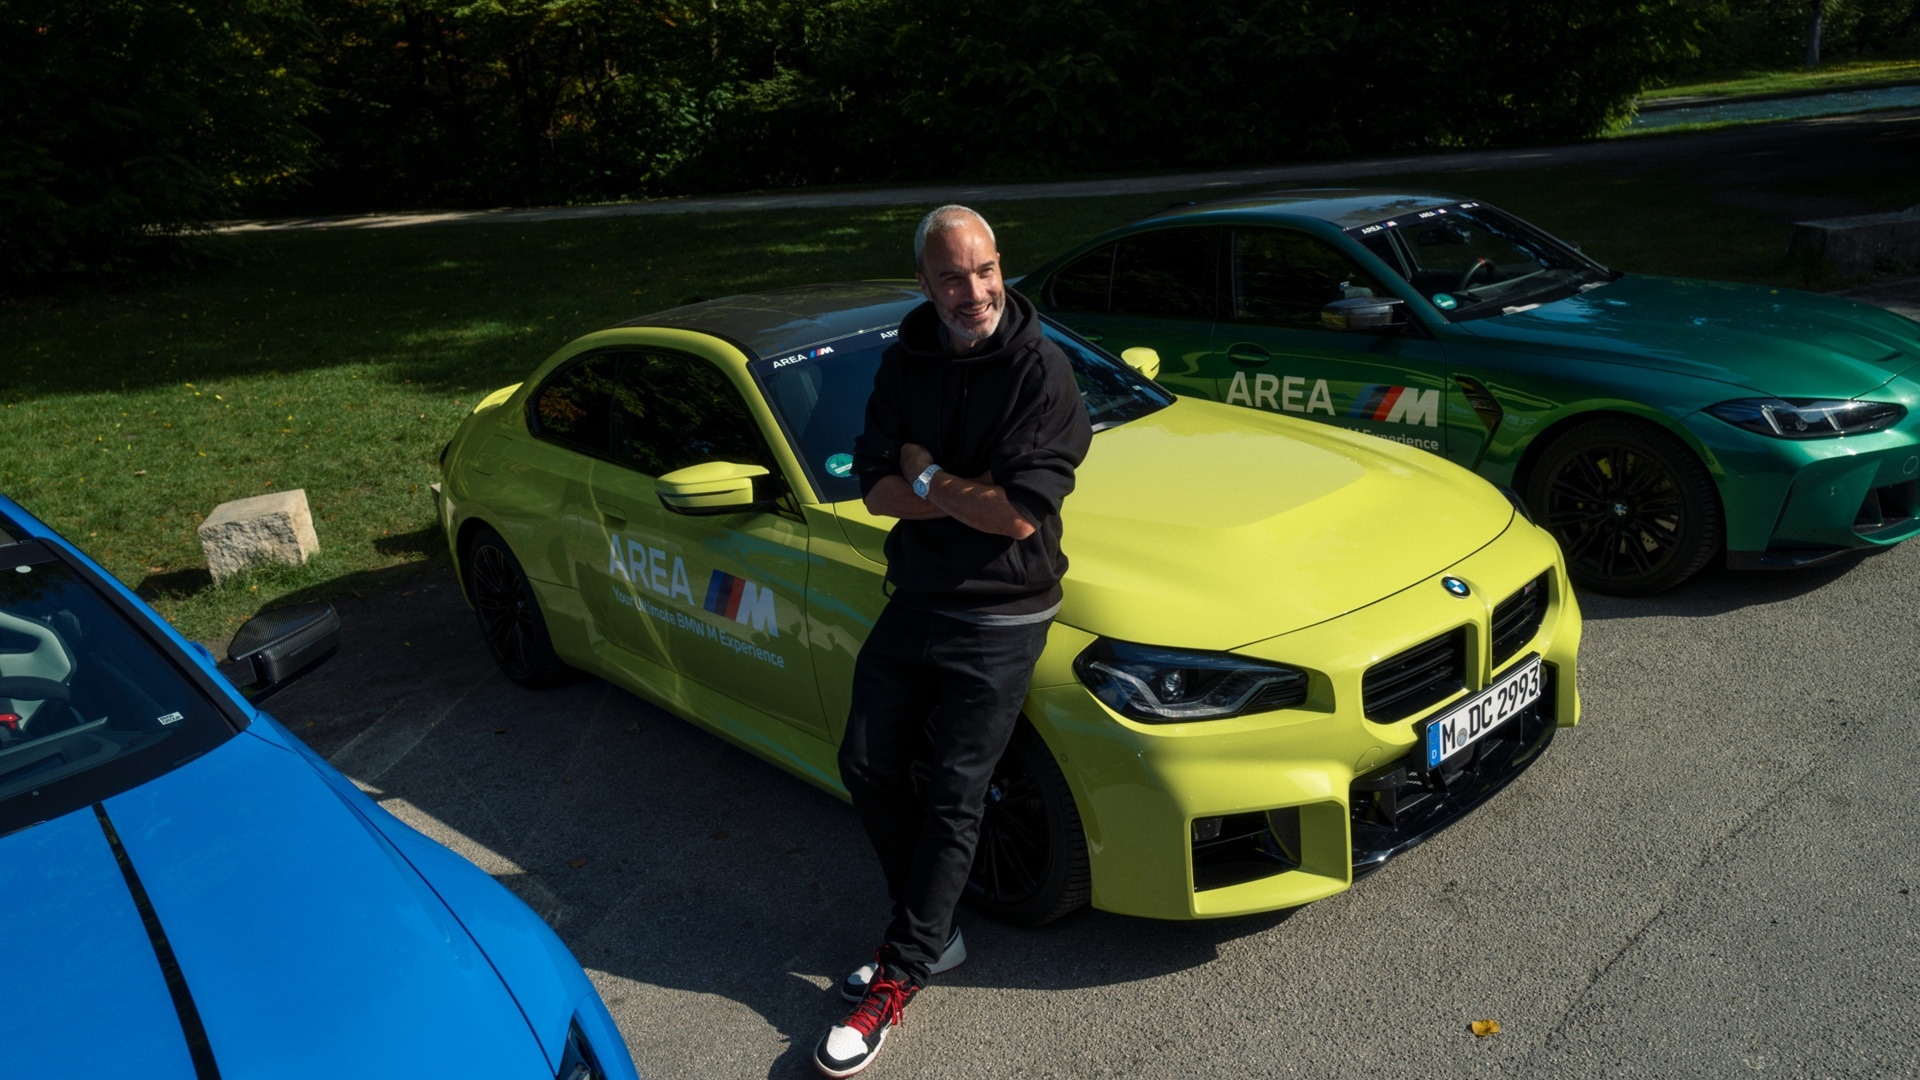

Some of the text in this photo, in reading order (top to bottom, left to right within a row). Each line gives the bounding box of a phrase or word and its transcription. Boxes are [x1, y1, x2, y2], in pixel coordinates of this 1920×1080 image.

[773, 353, 808, 369] AREA
[1226, 371, 1336, 416] AREA
[609, 534, 695, 606] AREA
[612, 585, 785, 669] Your Ultimate BMW M Experience
[1442, 666, 1539, 755] M DC 2993
